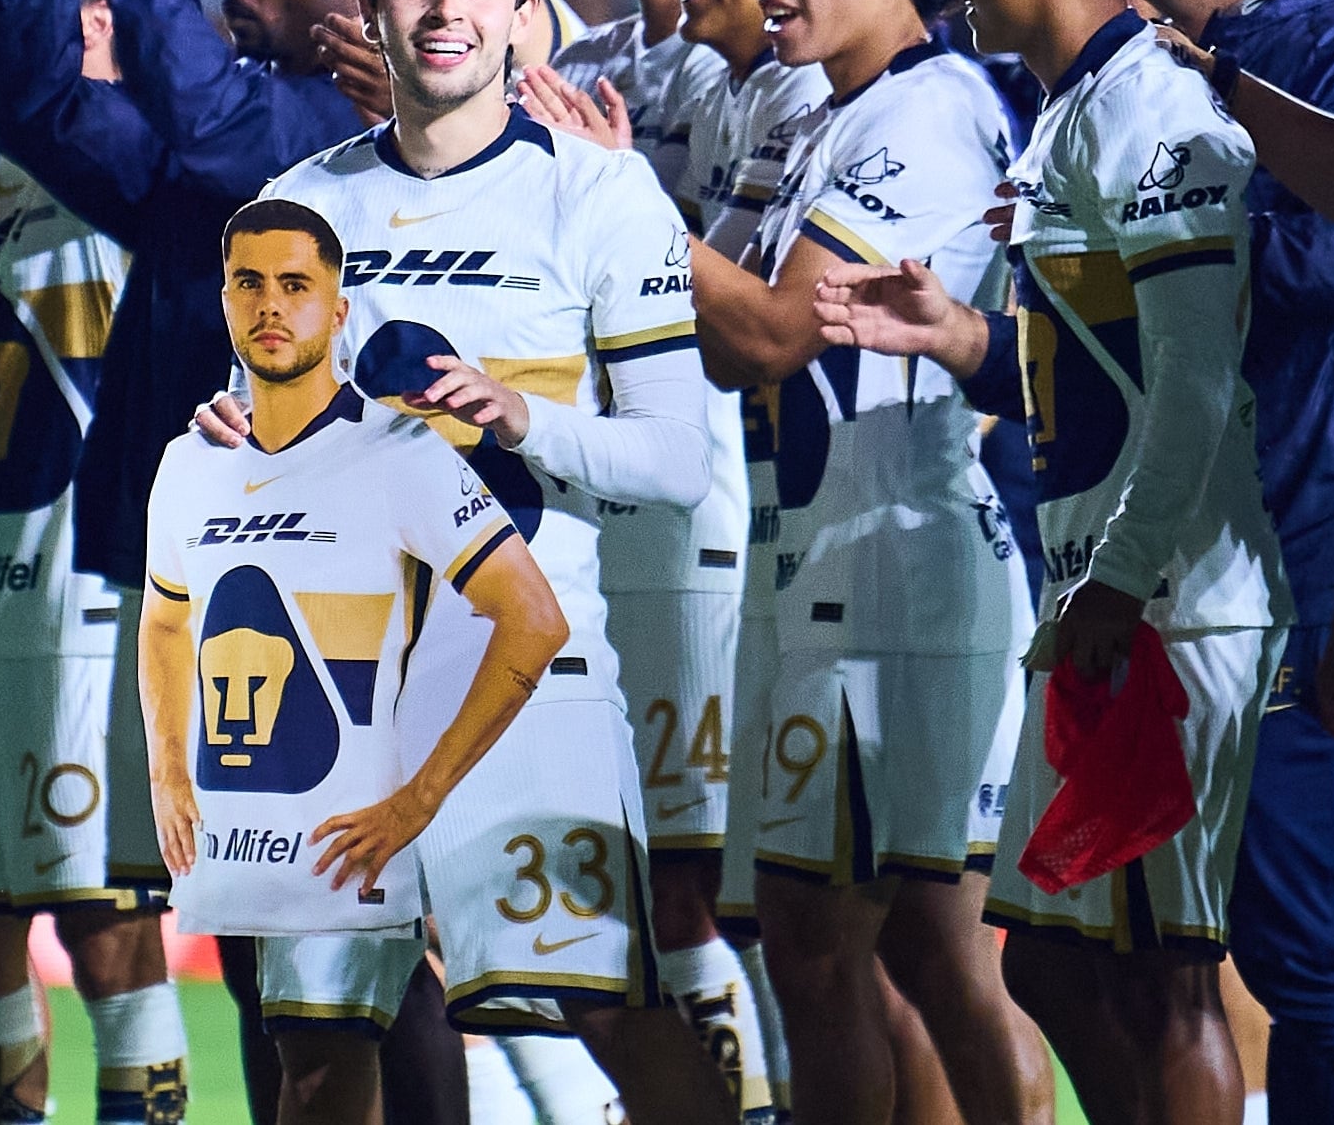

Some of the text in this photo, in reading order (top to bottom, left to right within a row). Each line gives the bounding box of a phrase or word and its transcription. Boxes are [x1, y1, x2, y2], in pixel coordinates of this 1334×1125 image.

[833, 178, 907, 221] LOY
[1121, 184, 1228, 224] RALOY
[341, 249, 505, 287] DHL
[197, 513, 312, 546] DHL
[644, 694, 729, 790] 24
[223, 828, 303, 864] Mifel
[495, 826, 616, 925] 33
